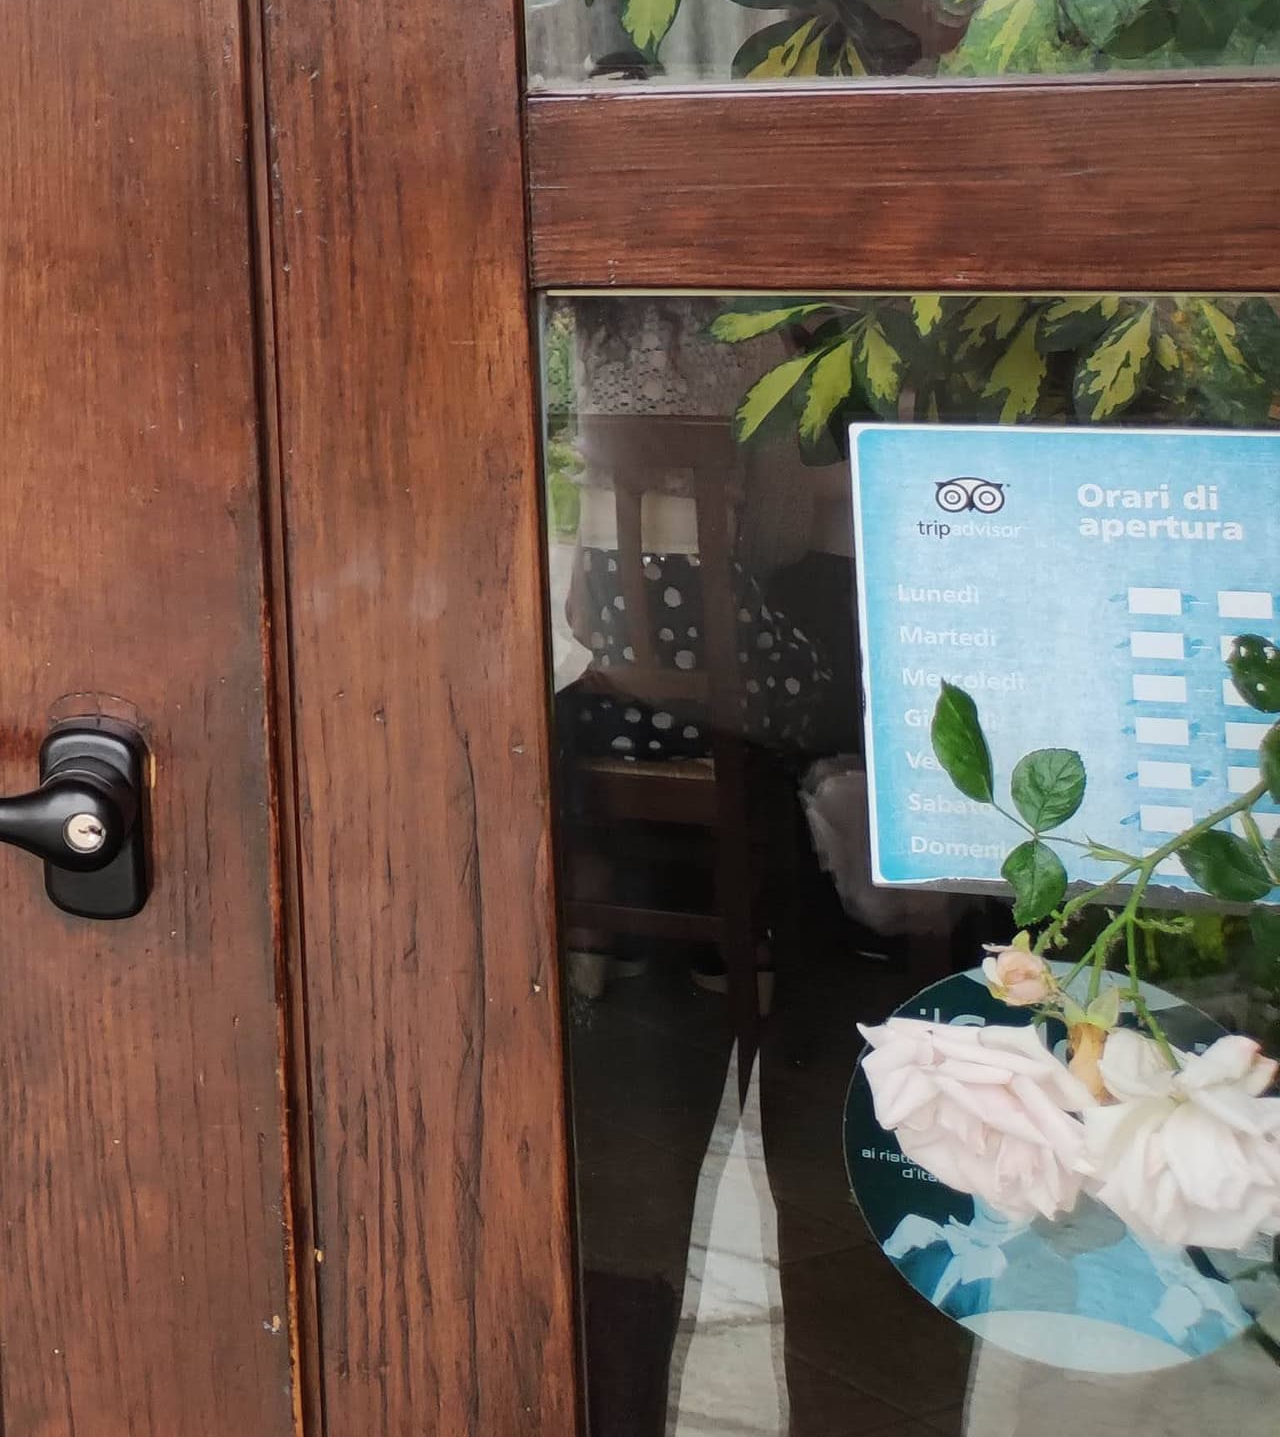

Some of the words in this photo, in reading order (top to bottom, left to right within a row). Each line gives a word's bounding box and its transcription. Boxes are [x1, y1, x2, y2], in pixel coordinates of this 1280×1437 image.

[1077, 483, 1170, 511] Orari
[1182, 484, 1219, 511] di
[917, 519, 1022, 539] tripadvisor
[1078, 513, 1244, 542] apertura
[911, 835, 1007, 859] Domeni
